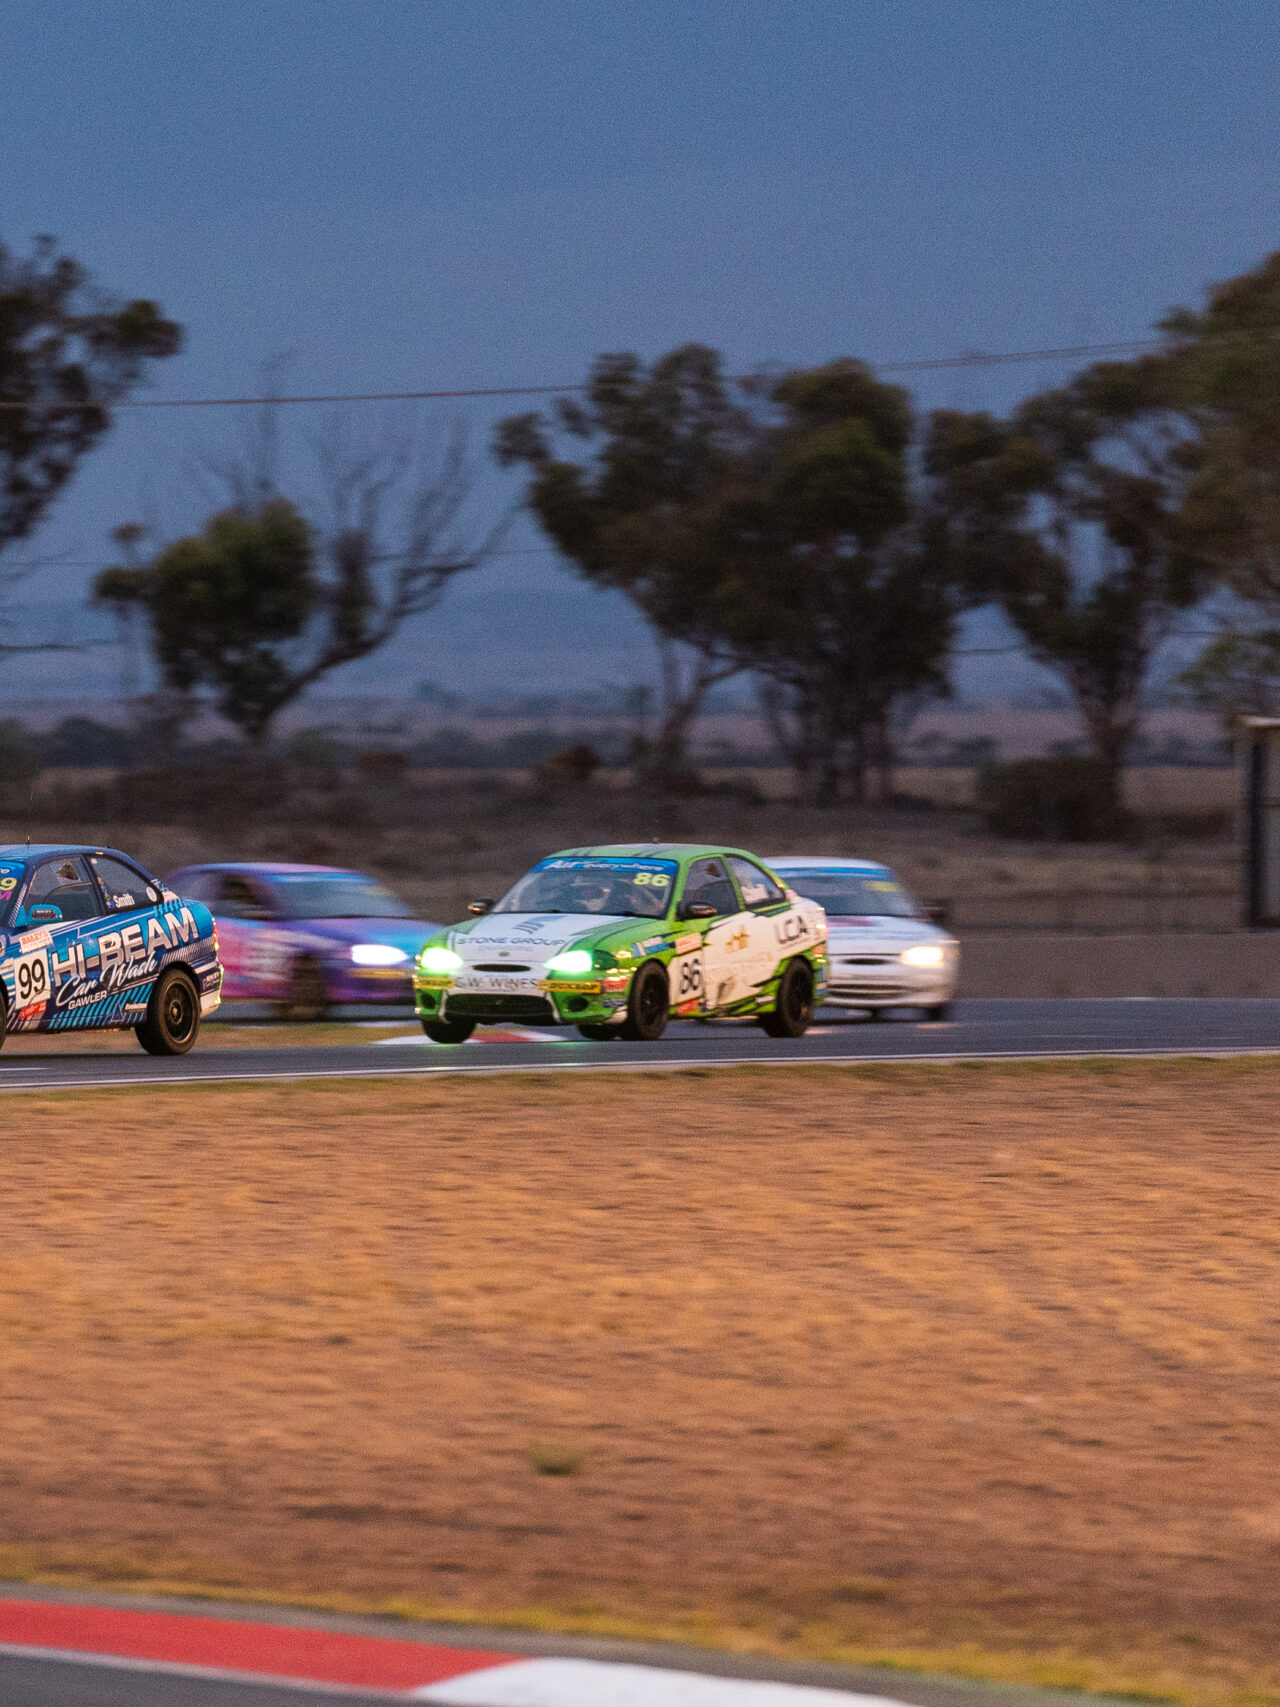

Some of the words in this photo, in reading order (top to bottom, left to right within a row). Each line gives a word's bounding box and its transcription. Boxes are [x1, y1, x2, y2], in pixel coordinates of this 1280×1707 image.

[633, 872, 670, 887] 86
[51, 907, 199, 987] HI-BEAM
[18, 958, 46, 1000] 99
[55, 975, 97, 1007] Car
[100, 951, 158, 991] Wash
[681, 958, 702, 994] 86
[68, 990, 108, 1010] GAWLER
